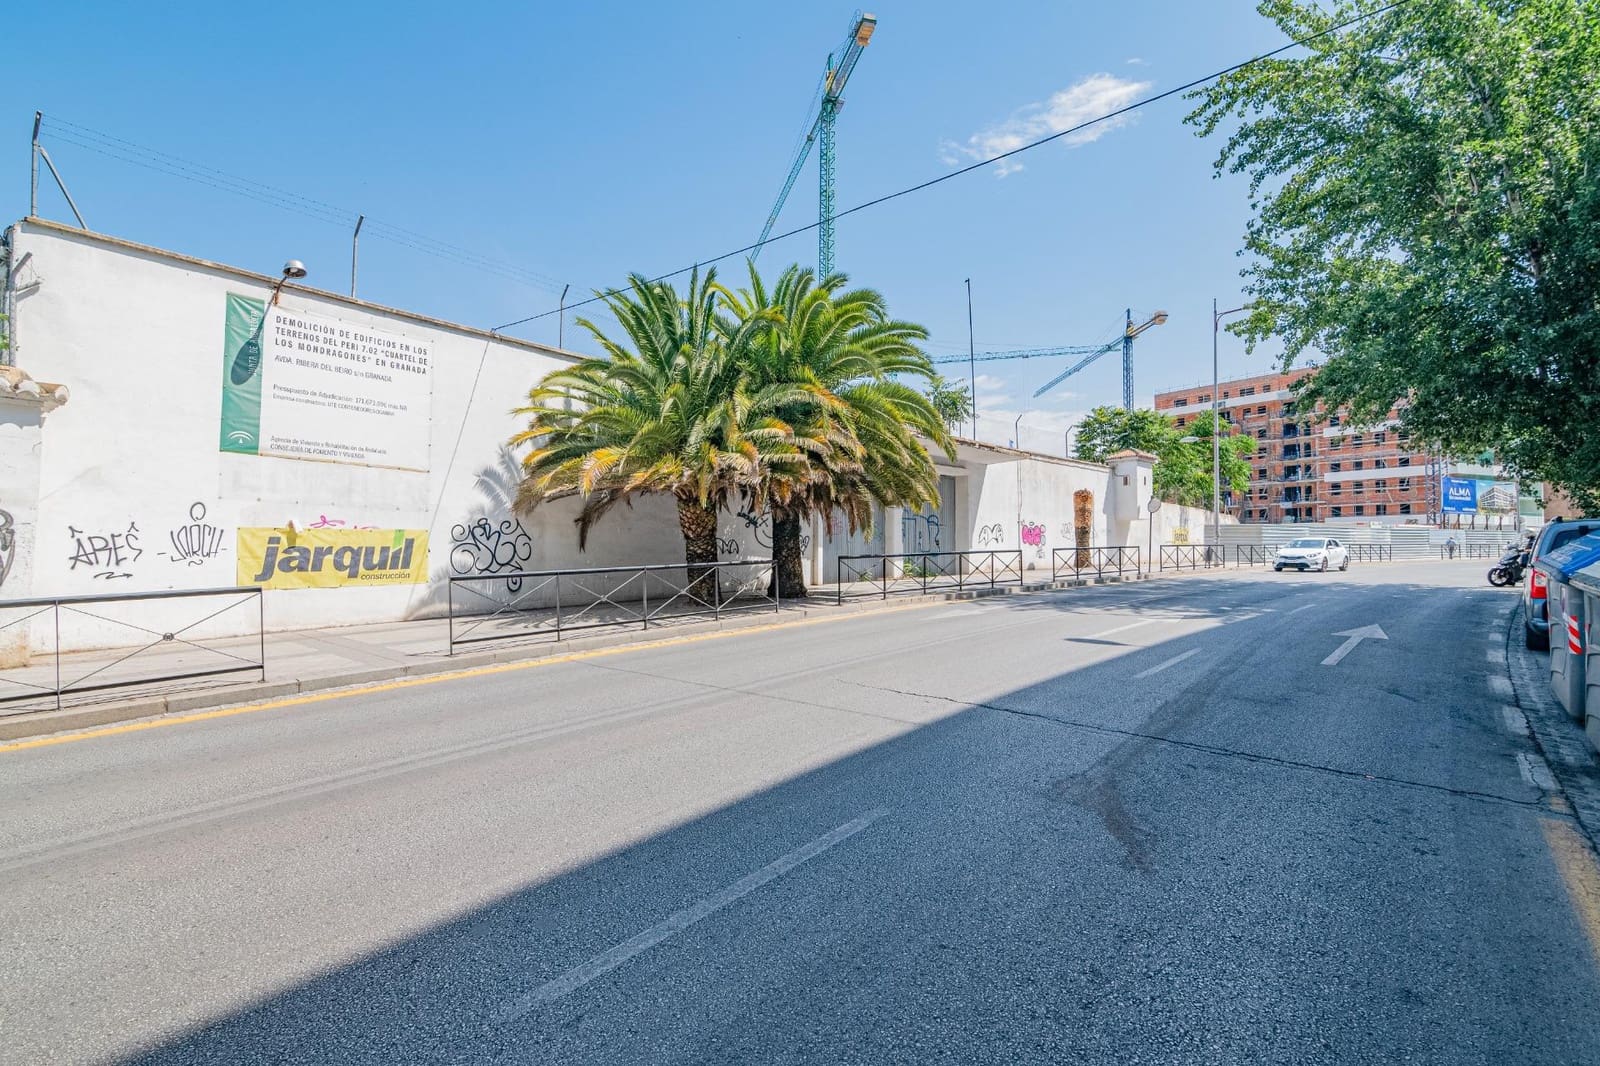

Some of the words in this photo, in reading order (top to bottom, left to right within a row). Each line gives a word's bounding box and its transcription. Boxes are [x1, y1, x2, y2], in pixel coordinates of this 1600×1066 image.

[275, 315, 335, 336] DEMOLICIÓN
[339, 329, 350, 339] DE
[354, 333, 396, 349] EDIFICIOS
[400, 343, 410, 352] EN
[413, 346, 428, 356] LOS
[275, 326, 320, 343] TERRENOS
[323, 336, 338, 347] DEL
[341, 340, 359, 351] PERI
[362, 345, 378, 355] 7.02
[418, 357, 428, 366] DE
[275, 337, 293, 349] LOS
[376, 358, 386, 367] EN
[390, 361, 427, 375] GRANADA
[296, 358, 319, 369] RIBERA
[320, 363, 333, 372] DEL
[1449, 487, 1471, 496] ALMA
[254, 536, 415, 582] jarquil
[360, 571, 410, 581] construcción
